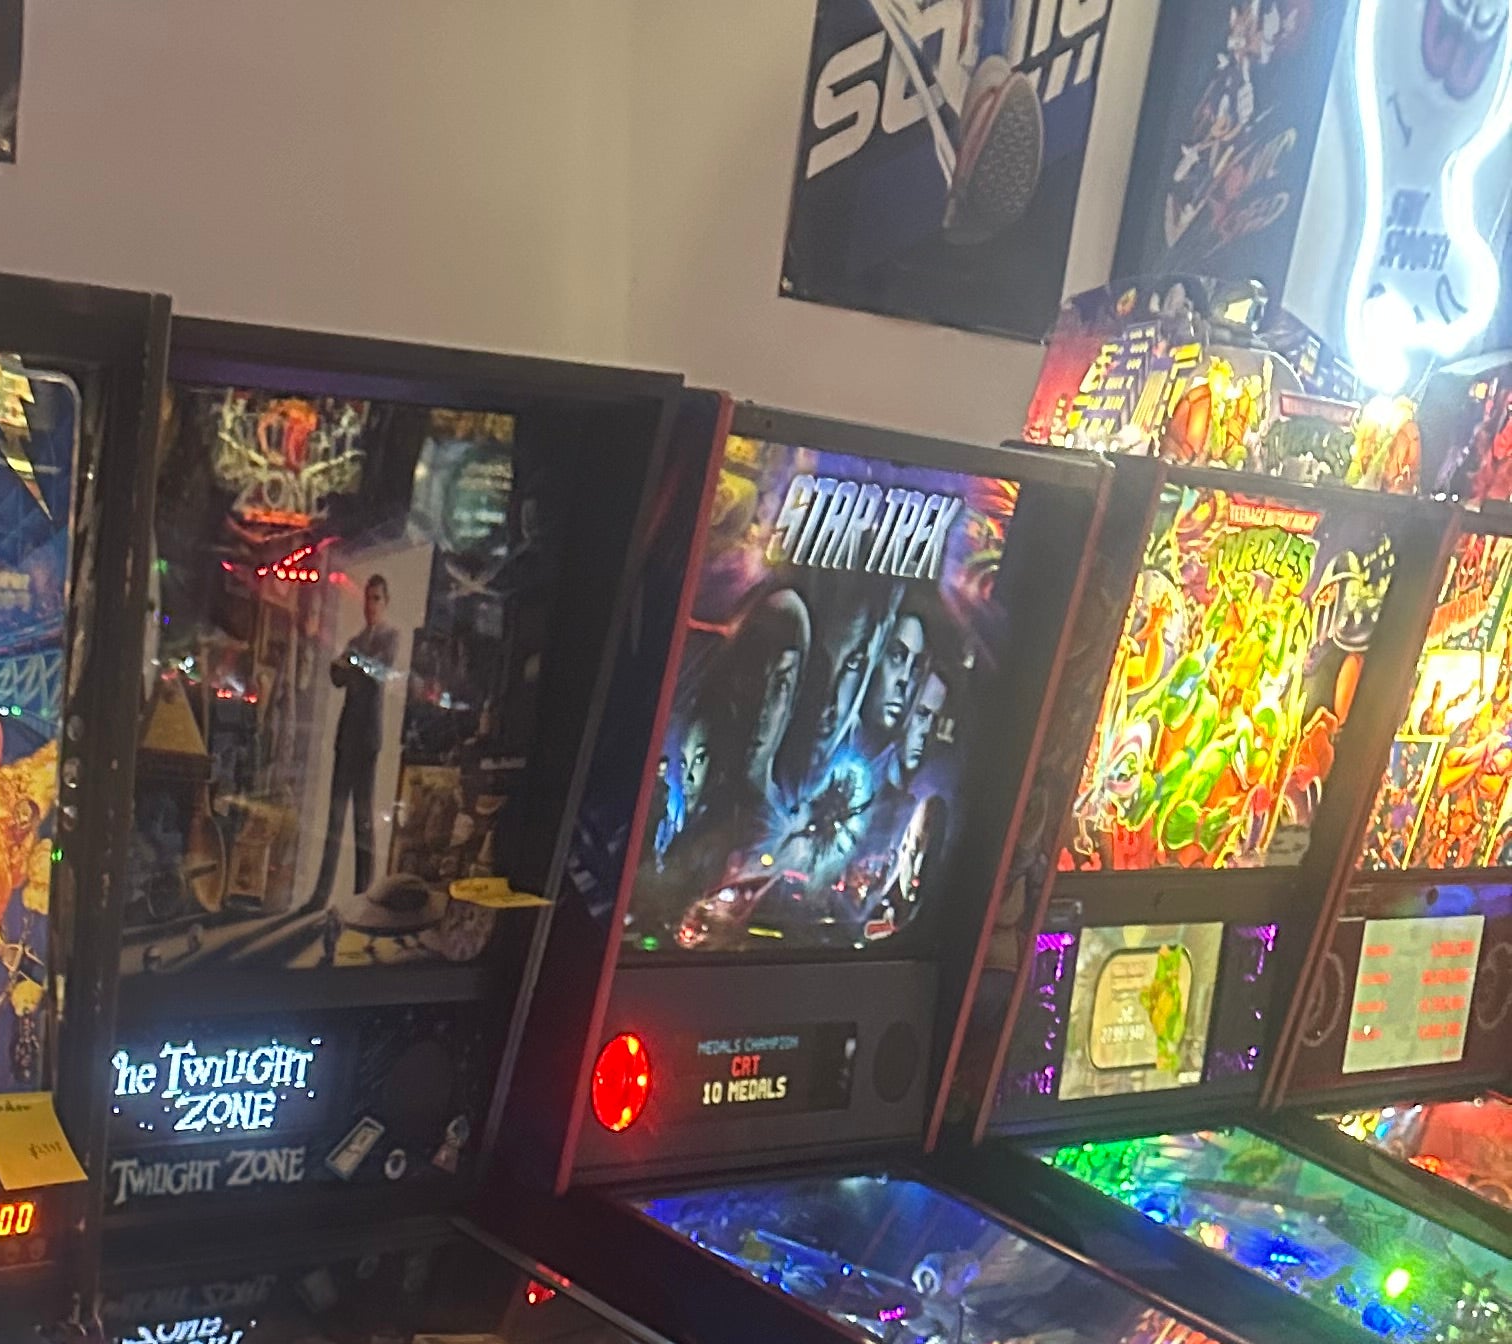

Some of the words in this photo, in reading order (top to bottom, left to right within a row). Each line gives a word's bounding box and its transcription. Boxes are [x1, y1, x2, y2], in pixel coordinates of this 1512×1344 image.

[766, 475, 883, 570] STAR
[865, 488, 964, 579] TREK
[731, 1055, 761, 1077] CRT
[174, 1090, 277, 1131] ZONE
[702, 1082, 723, 1105] 10
[727, 1076, 787, 1103] MEDALS
[111, 1160, 221, 1205] TWILIGHT
[226, 1146, 307, 1186] ZONE
